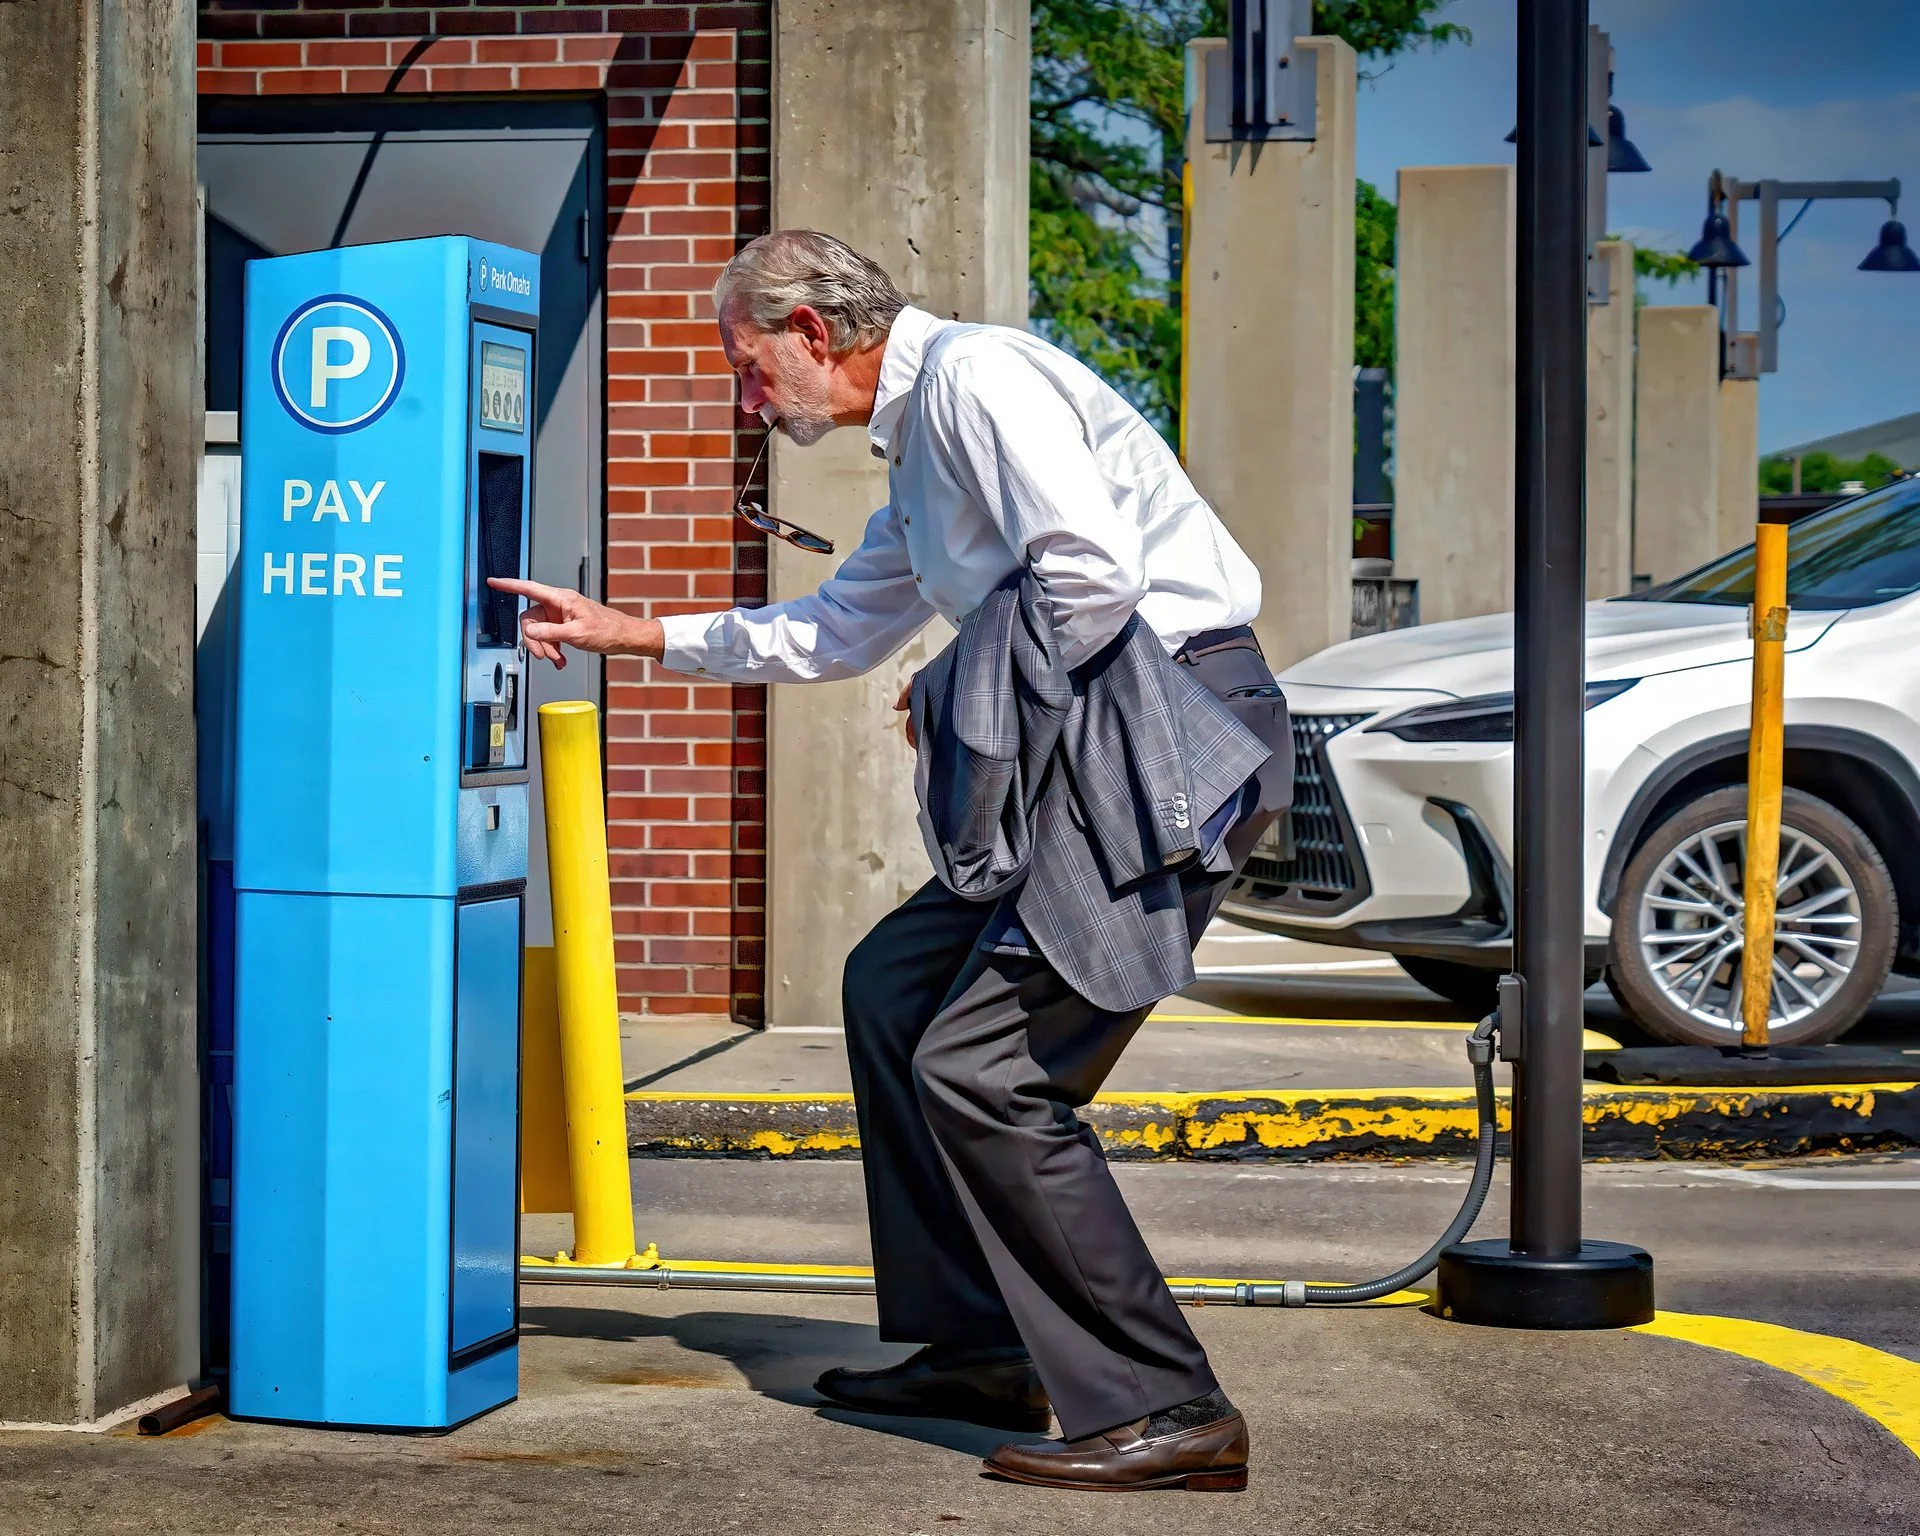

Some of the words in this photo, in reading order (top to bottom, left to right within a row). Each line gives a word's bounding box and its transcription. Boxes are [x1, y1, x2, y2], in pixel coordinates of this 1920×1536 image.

[491, 267, 507, 291] Park
[507, 271, 530, 296] Omaha
[310, 326, 371, 408] P
[283, 479, 387, 523] PAY
[263, 552, 404, 597] HERE
